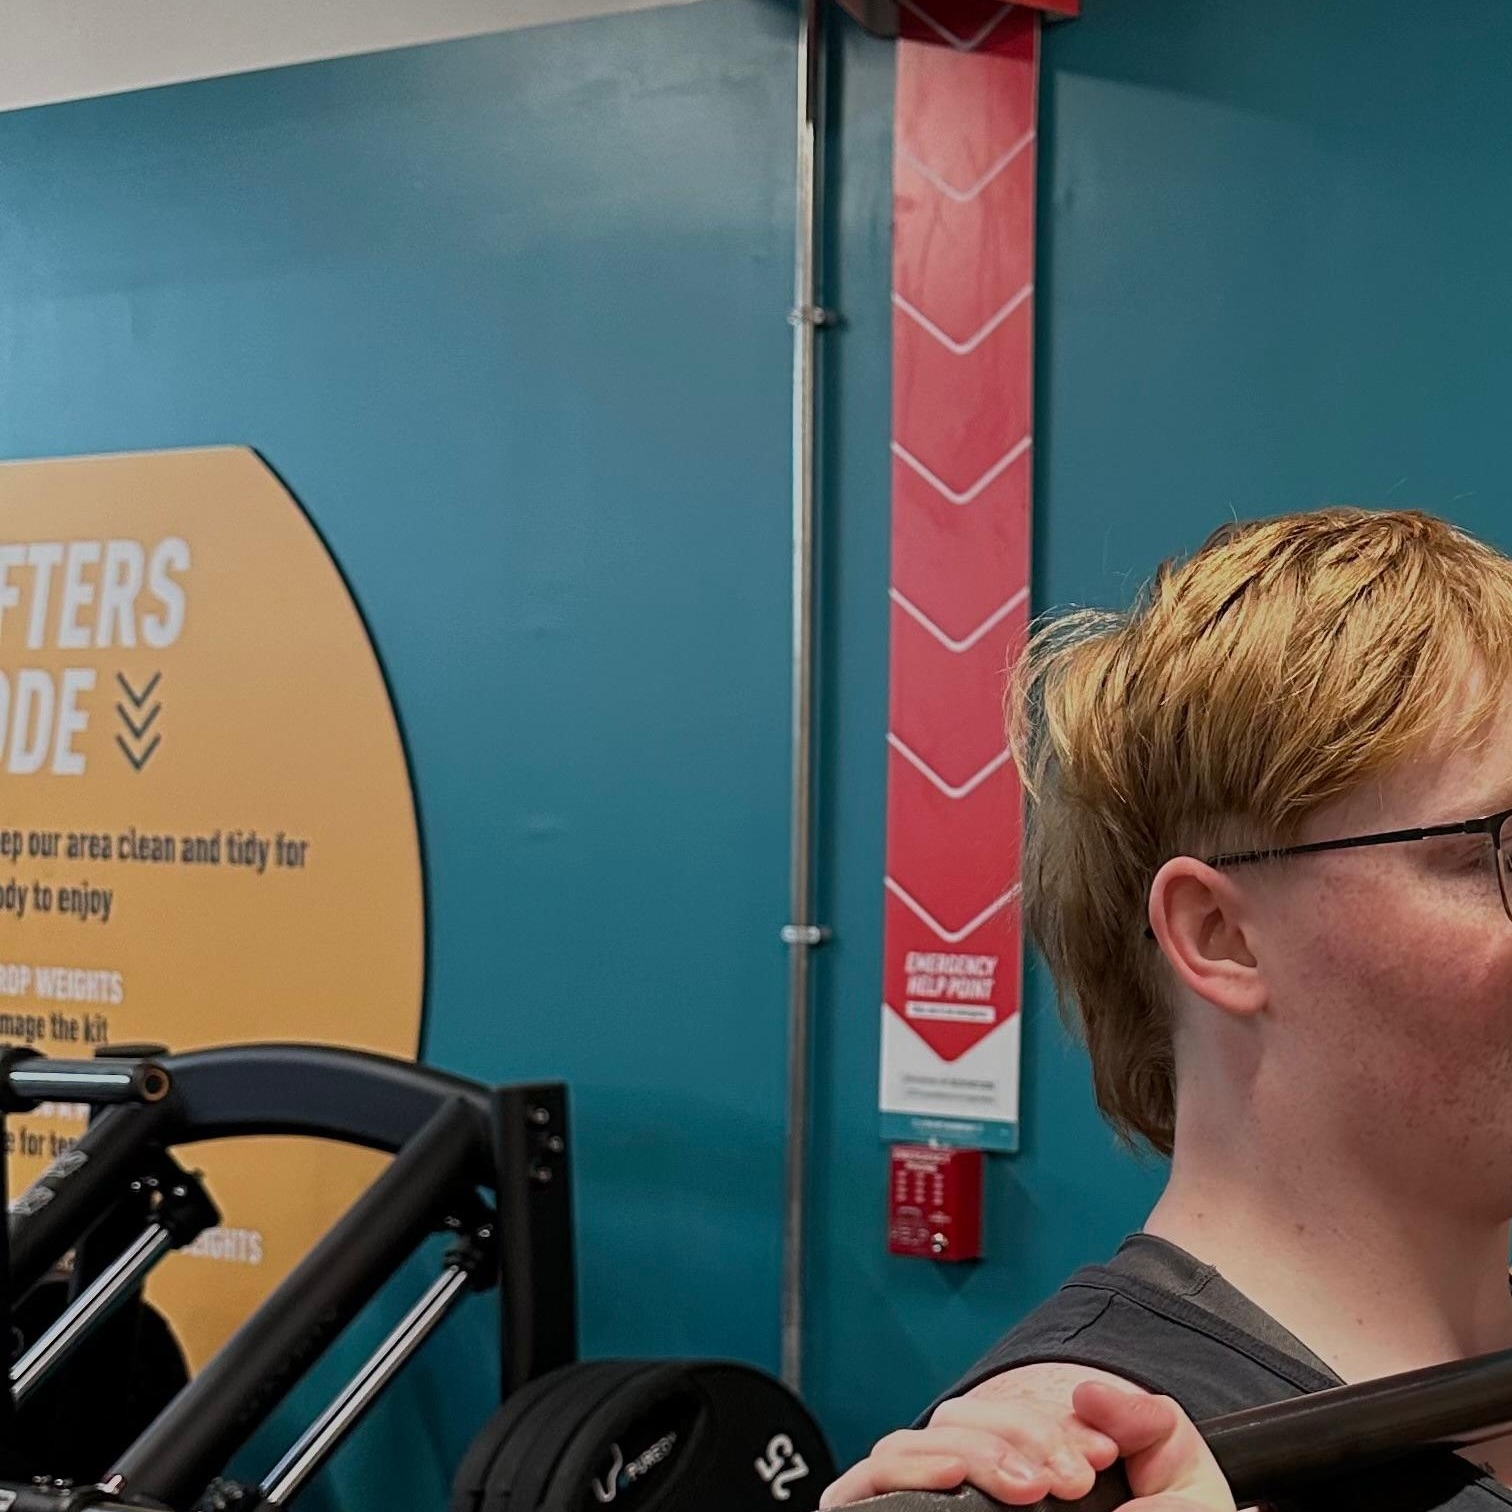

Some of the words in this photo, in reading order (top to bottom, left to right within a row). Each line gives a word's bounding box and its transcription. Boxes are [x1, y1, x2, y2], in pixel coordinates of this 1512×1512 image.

[0, 536, 191, 650] FTERS
[0, 666, 97, 776] DE
[0, 832, 23, 865] ep
[29, 832, 61, 858] our
[67, 832, 112, 859] area
[117, 826, 176, 863] clean
[181, 829, 221, 865] and
[226, 829, 270, 875] tidy
[275, 831, 308, 869] for
[33, 878, 53, 912] to
[58, 880, 114, 922] enjoy
[35, 965, 124, 1005] WEIGHTS
[0, 1013, 46, 1043] mage
[49, 1010, 79, 1041] the
[83, 1011, 108, 1043] kit
[19, 1126, 44, 1156] for
[180, 1226, 264, 1265] IGHTS
[753, 1432, 810, 1501] 25
